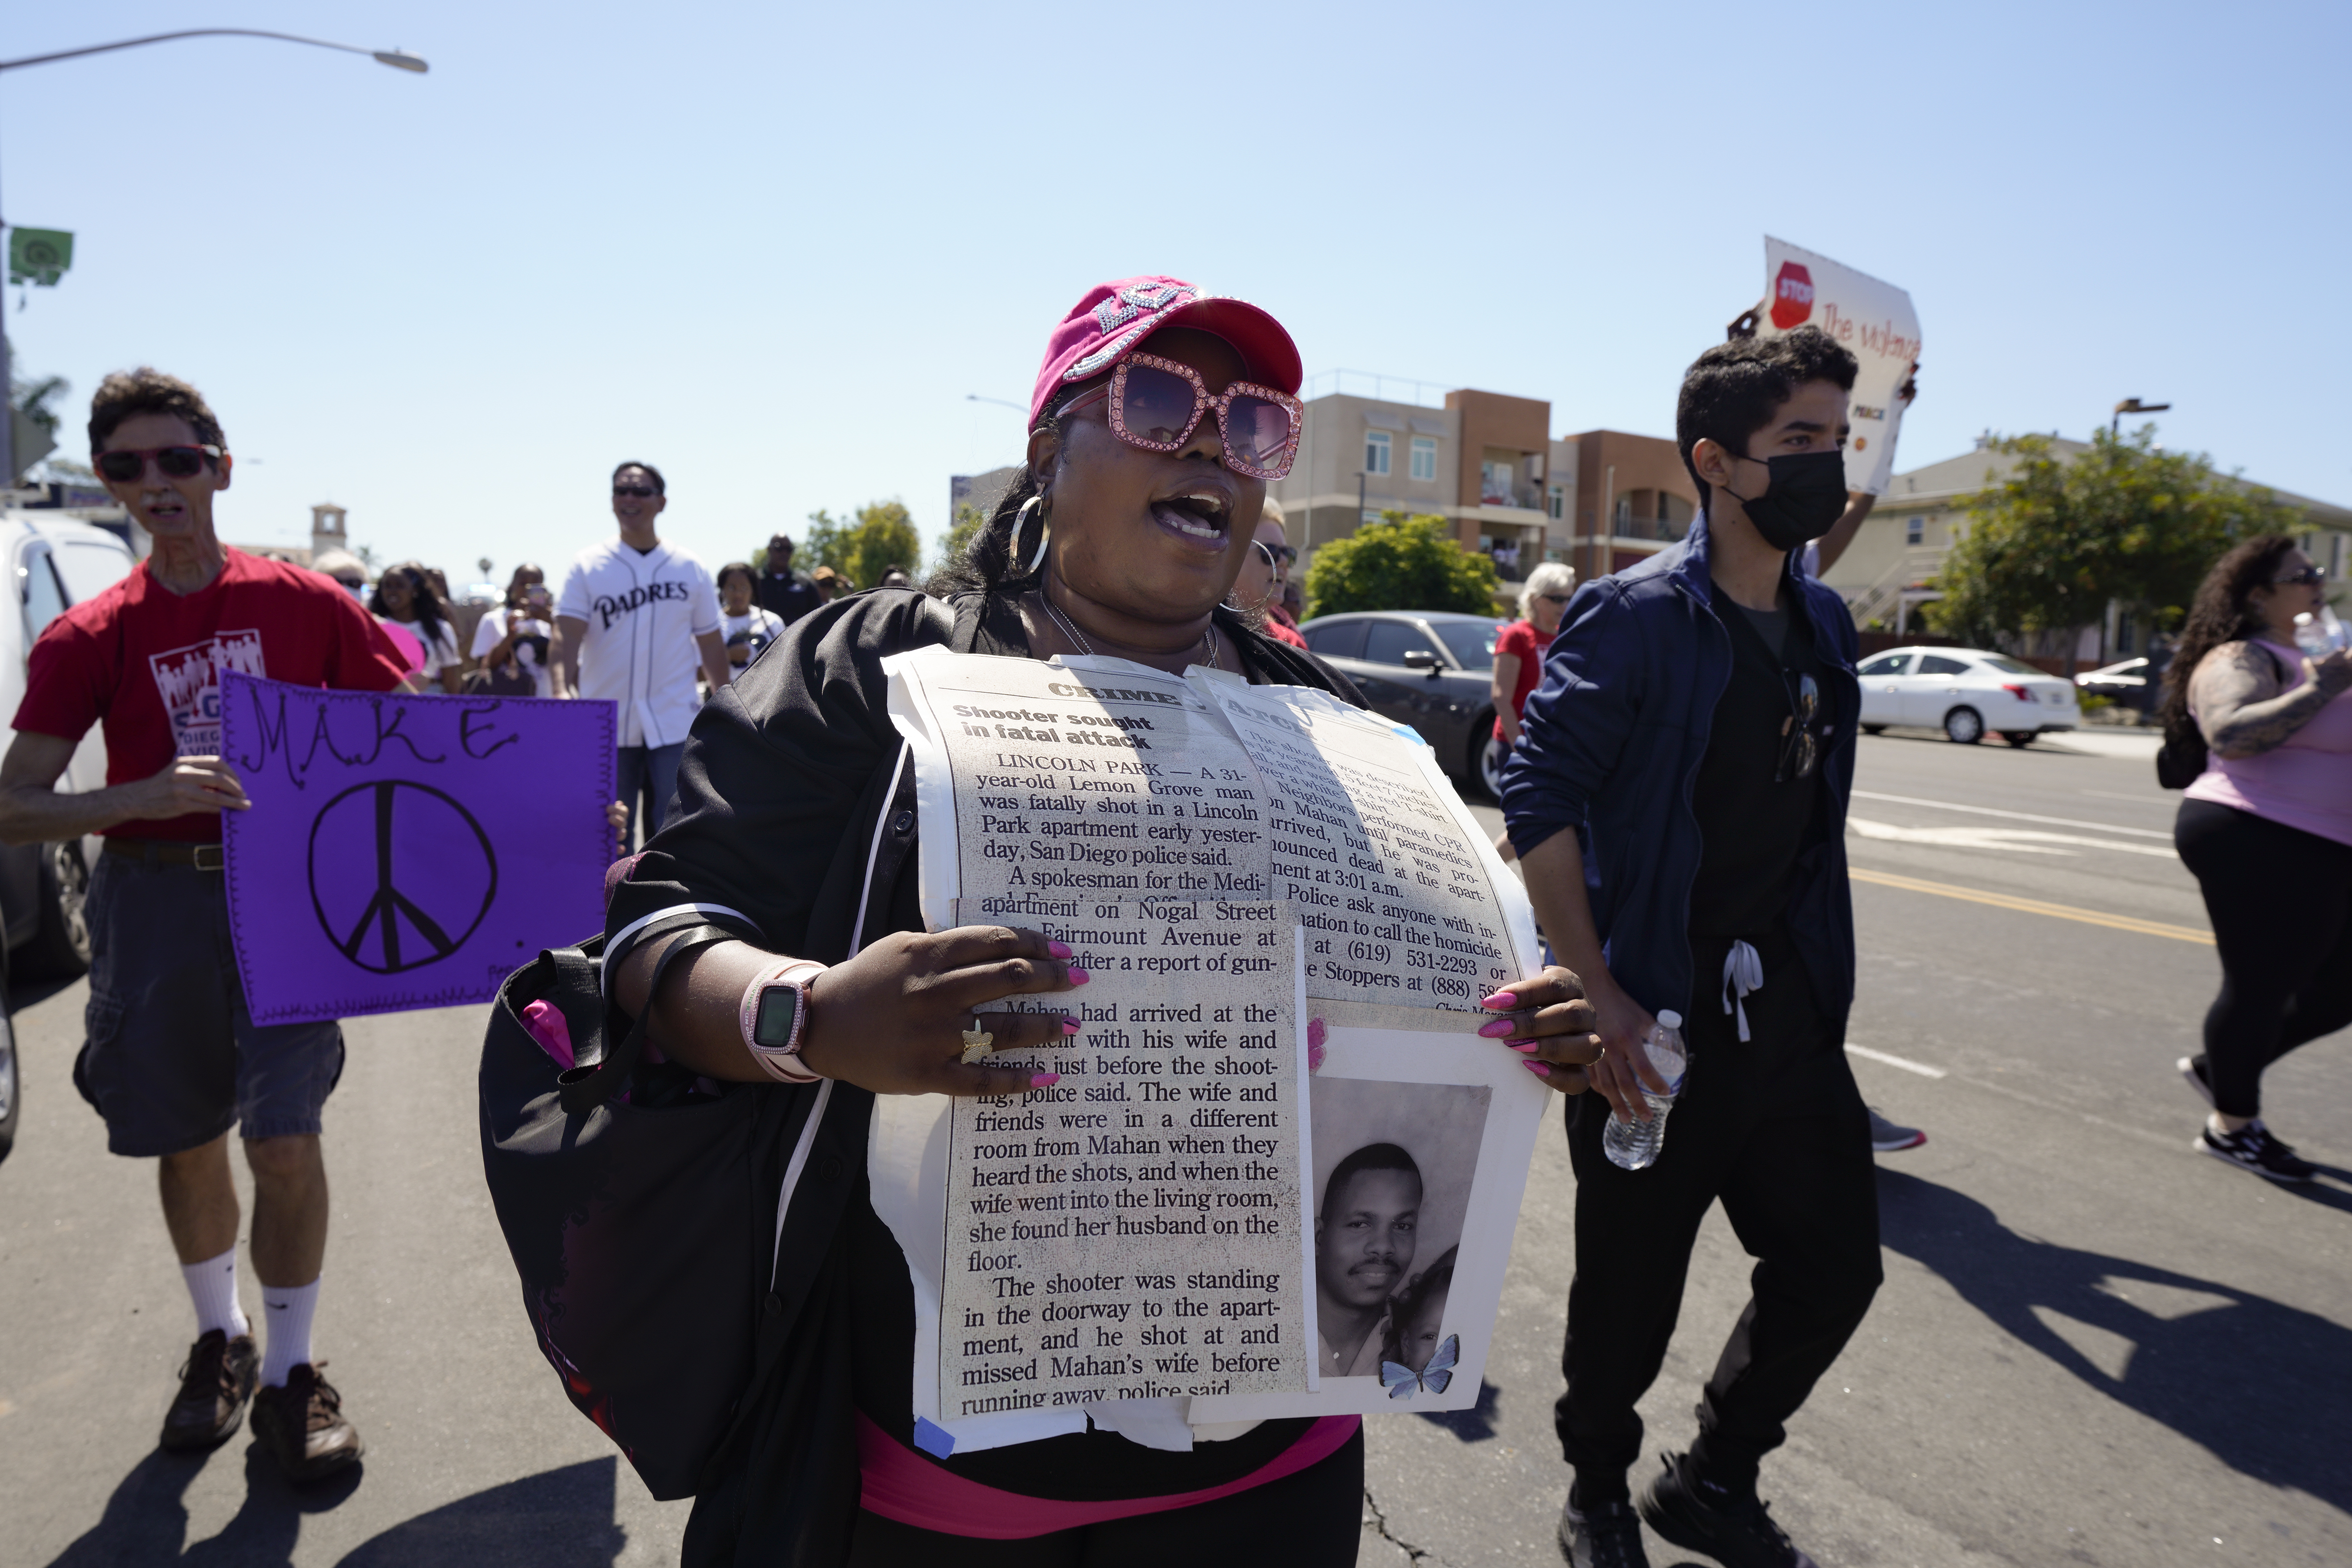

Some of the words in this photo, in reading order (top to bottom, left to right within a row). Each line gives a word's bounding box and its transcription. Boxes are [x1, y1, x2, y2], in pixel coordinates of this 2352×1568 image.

[1779, 277, 1814, 305] STOP
[1823, 302, 1854, 342] The
[593, 581, 688, 631] PADRES
[1048, 683, 1183, 707] CRIME
[953, 705, 1058, 723] Shooter
[1066, 714, 1155, 731] sought
[1220, 696, 1318, 741] ATCH
[184, 730, 220, 744] DIEG
[240, 684, 520, 790] MAKE
[960, 721, 990, 737] in
[994, 724, 1061, 743] fatal
[1065, 730, 1152, 750] attack
[995, 753, 1096, 773] LINCOLN
[1104, 760, 1164, 777] PARK
[1200, 766, 1216, 780] A
[1219, 768, 1247, 782] 31-
[1245, 729, 1276, 747] The
[1280, 742, 1331, 766] shooter
[1336, 763, 1363, 777] was
[1366, 773, 1430, 799] described
[1256, 743, 1275, 755] 18
[1277, 751, 1316, 769] years
[1318, 764, 1345, 781] old,
[1345, 773, 1355, 783] 5
[1356, 777, 1385, 793] feet
[1383, 787, 1392, 795] 7
[1392, 792, 1439, 810] inches
[975, 774, 1057, 790] year-old
[1068, 776, 1137, 793] Lemon
[1148, 780, 1203, 797] Grove
[1216, 787, 1255, 800] man
[1276, 760, 1304, 775] and
[1306, 770, 1364, 797] wearing
[1377, 795, 1401, 808] red
[1400, 801, 1448, 824] T-shirt
[1290, 775, 1300, 784] a
[1301, 779, 1342, 799] white
[1341, 790, 1394, 816] T-shirt.
[981, 815, 1031, 833] Park
[1040, 820, 1139, 838] apartment
[1148, 823, 1193, 844] early
[1200, 827, 1262, 845] yester-
[1276, 780, 1356, 816] Neighbors
[1359, 811, 1432, 841] performed
[1434, 833, 1467, 854] CPR
[1293, 800, 1348, 829] Mahan
[1355, 824, 1389, 842] until
[1396, 836, 1473, 869] paramedics
[983, 839, 1025, 862] day,
[1030, 840, 1065, 860] San
[1069, 843, 1127, 866] Diego
[1132, 845, 1187, 867] police
[1191, 848, 1232, 866] said.
[1343, 832, 1371, 852] but
[1380, 844, 1401, 860] he
[1412, 857, 1441, 873] was
[1451, 869, 1479, 884] pro-
[1008, 865, 1027, 885] A
[1031, 868, 1139, 889] spokesman
[1145, 871, 1173, 889] for
[1177, 871, 1207, 890] the
[1214, 873, 1266, 891] Medi-
[1315, 869, 1331, 883] at
[1335, 869, 1367, 891] 3:01
[1372, 881, 1404, 898] a.m.
[1348, 853, 1385, 874] dead
[1394, 867, 1408, 880] at
[1416, 871, 1440, 888] the
[1447, 883, 1486, 902] apart-
[981, 898, 1079, 917] apartment
[1095, 904, 1120, 919] on
[1137, 901, 1199, 924] Nogal
[1215, 901, 1277, 921] Street
[1287, 883, 1339, 907] Police
[1347, 896, 1376, 914] ask
[1382, 904, 1437, 926] anyone
[1442, 916, 1475, 934] with
[1478, 922, 1497, 939] in-
[1041, 922, 1148, 945] Fairmount
[1161, 927, 1242, 946] Avenue
[1257, 930, 1277, 946] at
[1353, 919, 1370, 935] to
[1373, 923, 1402, 941] call
[1405, 927, 1431, 946] the
[1433, 931, 1503, 959] homicide
[1071, 951, 1116, 970] after
[1120, 956, 1132, 970] a
[1137, 954, 1201, 975] report
[1206, 952, 1228, 972] of
[1230, 957, 1277, 975] gun-
[1314, 938, 1332, 955] at
[1348, 940, 1391, 965] (619)
[1406, 949, 1478, 976] 531-2293
[1490, 967, 1507, 980] or
[1325, 961, 1400, 988] Stoppers
[1407, 976, 1423, 991] at
[1431, 976, 1470, 1000] (888)
[1080, 1002, 1118, 1022] had
[1129, 1003, 1202, 1023] arrived
[1213, 1004, 1233, 1023] at
[1244, 1003, 1277, 1023] the
[1086, 1029, 1131, 1049] with
[1142, 1029, 1174, 1049] his
[1184, 1029, 1228, 1049] wife
[1239, 1029, 1277, 1049] and
[1053, 1055, 1088, 1075] just
[1096, 1055, 1163, 1075] before
[1172, 1056, 1205, 1075] the
[1215, 1056, 1278, 1076] shoot-
[1021, 1083, 1078, 1108] police
[1084, 1081, 1131, 1102] said.
[1138, 1082, 1181, 1102] The
[1188, 1081, 1232, 1102] wife
[1239, 1081, 1278, 1102] and
[973, 1143, 1028, 1160] room
[1033, 1137, 1079, 1157] from
[1086, 1134, 1161, 1155] Mahan
[1168, 1136, 1225, 1154] when
[1232, 1136, 1277, 1158] they
[970, 1193, 1013, 1215] wife
[1019, 1193, 1067, 1212] went
[1070, 1190, 1110, 1210] into
[1115, 1189, 1149, 1209] the
[1153, 1188, 1212, 1212] living
[1216, 1193, 1279, 1211] room,
[992, 1276, 1035, 1298] The
[1046, 1273, 1126, 1294] shooter
[1135, 1275, 1176, 1290] was
[1187, 1269, 1280, 1292] standing
[962, 1336, 1024, 1357] ment,
[1041, 1329, 1078, 1351] and
[1096, 1325, 1123, 1348] he
[1141, 1324, 1188, 1346] shot
[1203, 1326, 1225, 1344] at
[1241, 1323, 1280, 1345] and
